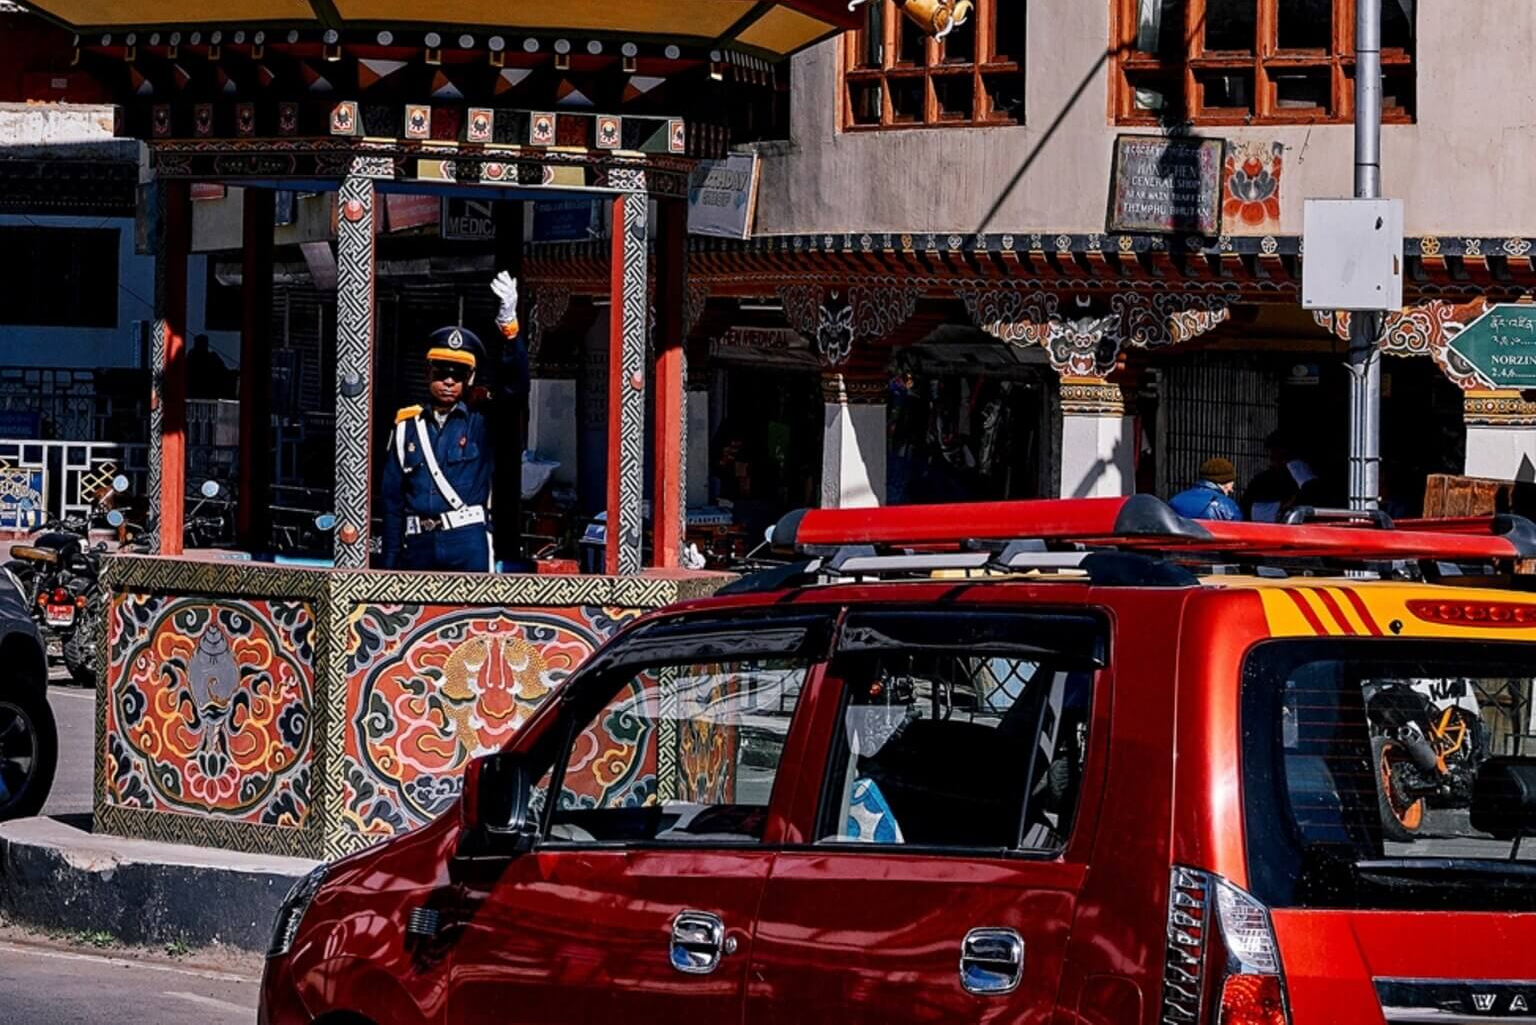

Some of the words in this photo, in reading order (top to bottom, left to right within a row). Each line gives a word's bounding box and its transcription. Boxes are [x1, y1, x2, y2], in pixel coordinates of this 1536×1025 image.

[1132, 175, 1175, 189] GENERAL
[1124, 202, 1167, 216] THIMPHU
[1491, 355, 1536, 366] NORZIN
